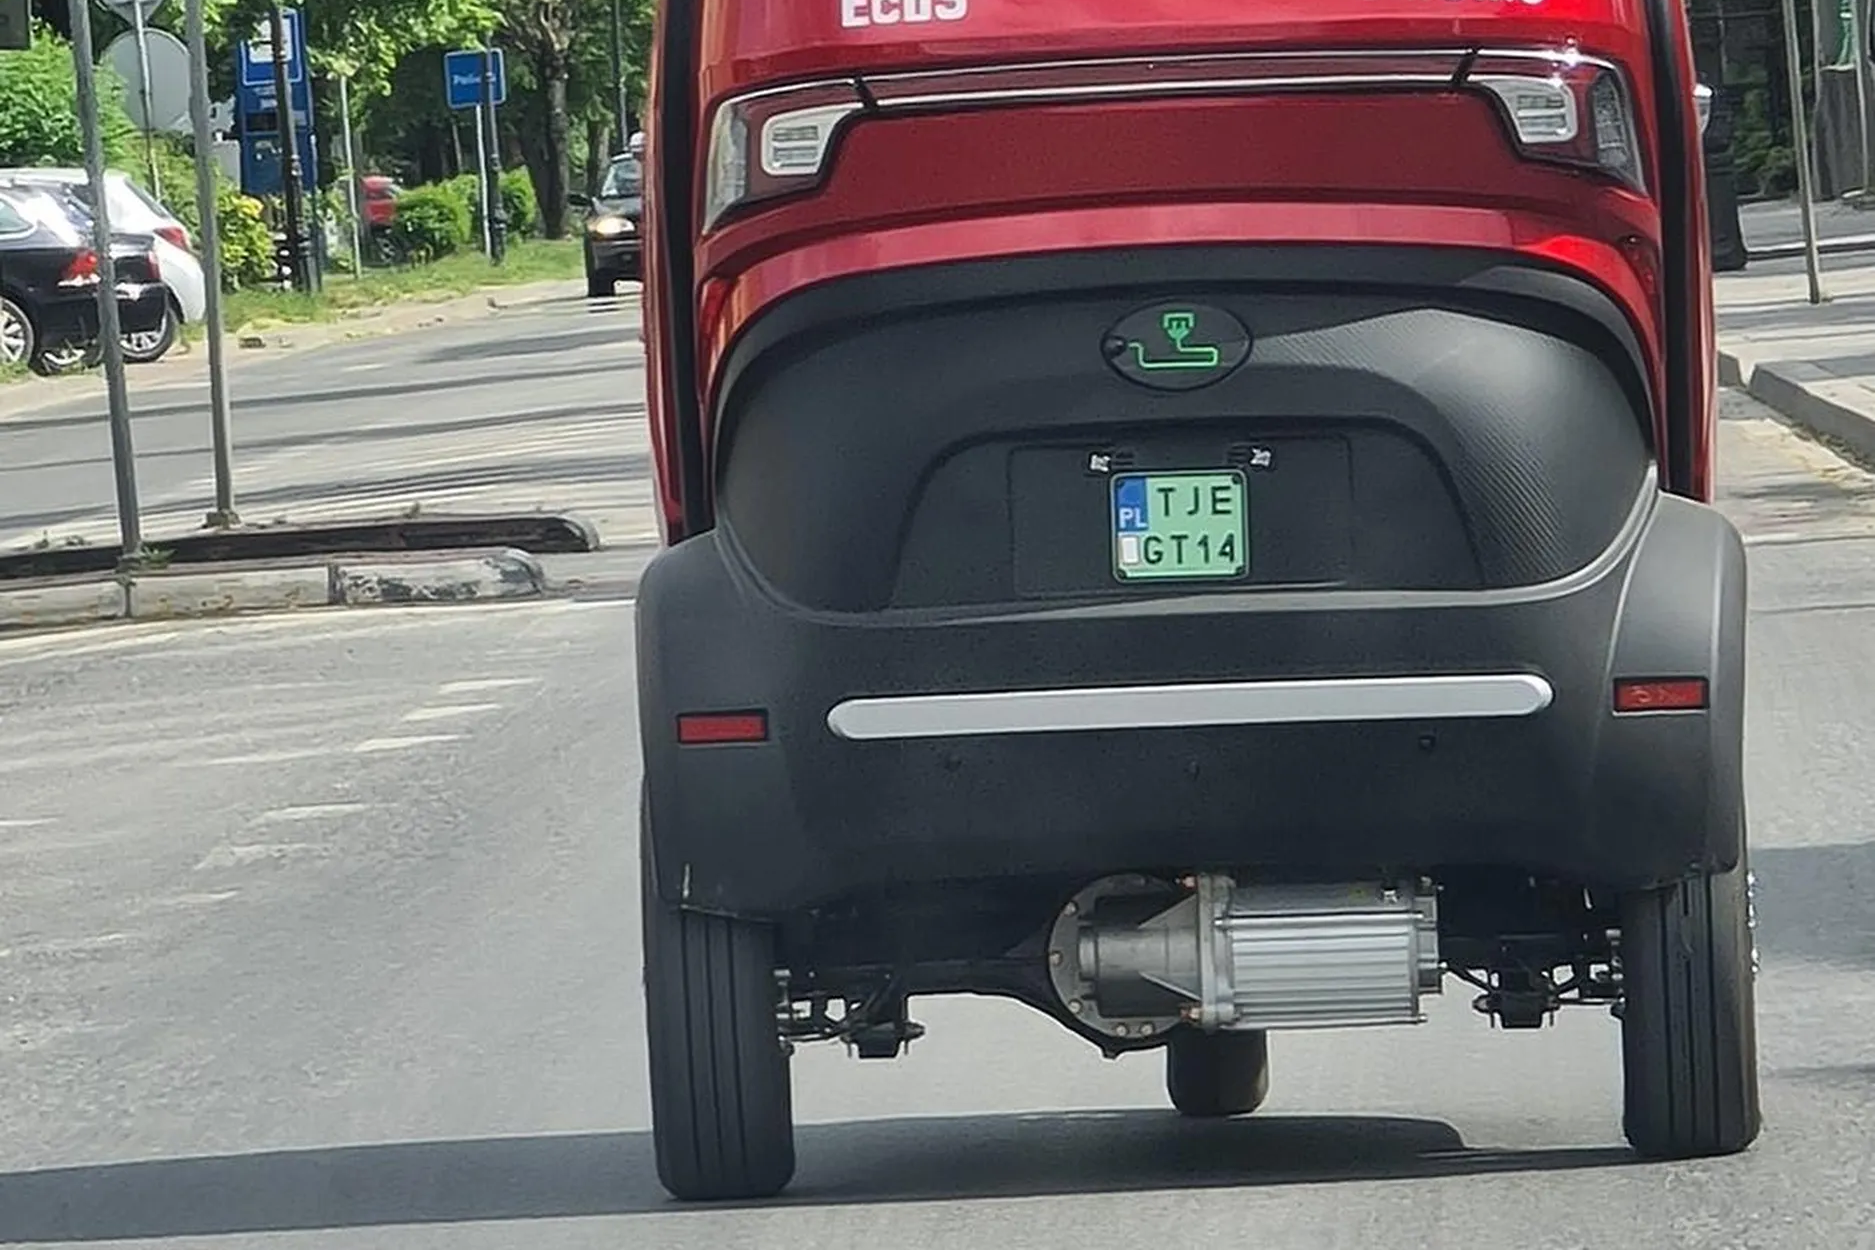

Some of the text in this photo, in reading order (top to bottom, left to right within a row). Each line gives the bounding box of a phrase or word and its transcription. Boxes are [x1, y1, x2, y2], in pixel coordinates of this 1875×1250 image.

[1156, 485, 1233, 517] TJE
[1118, 507, 1148, 529] PL
[1143, 534, 1236, 566] GT14
